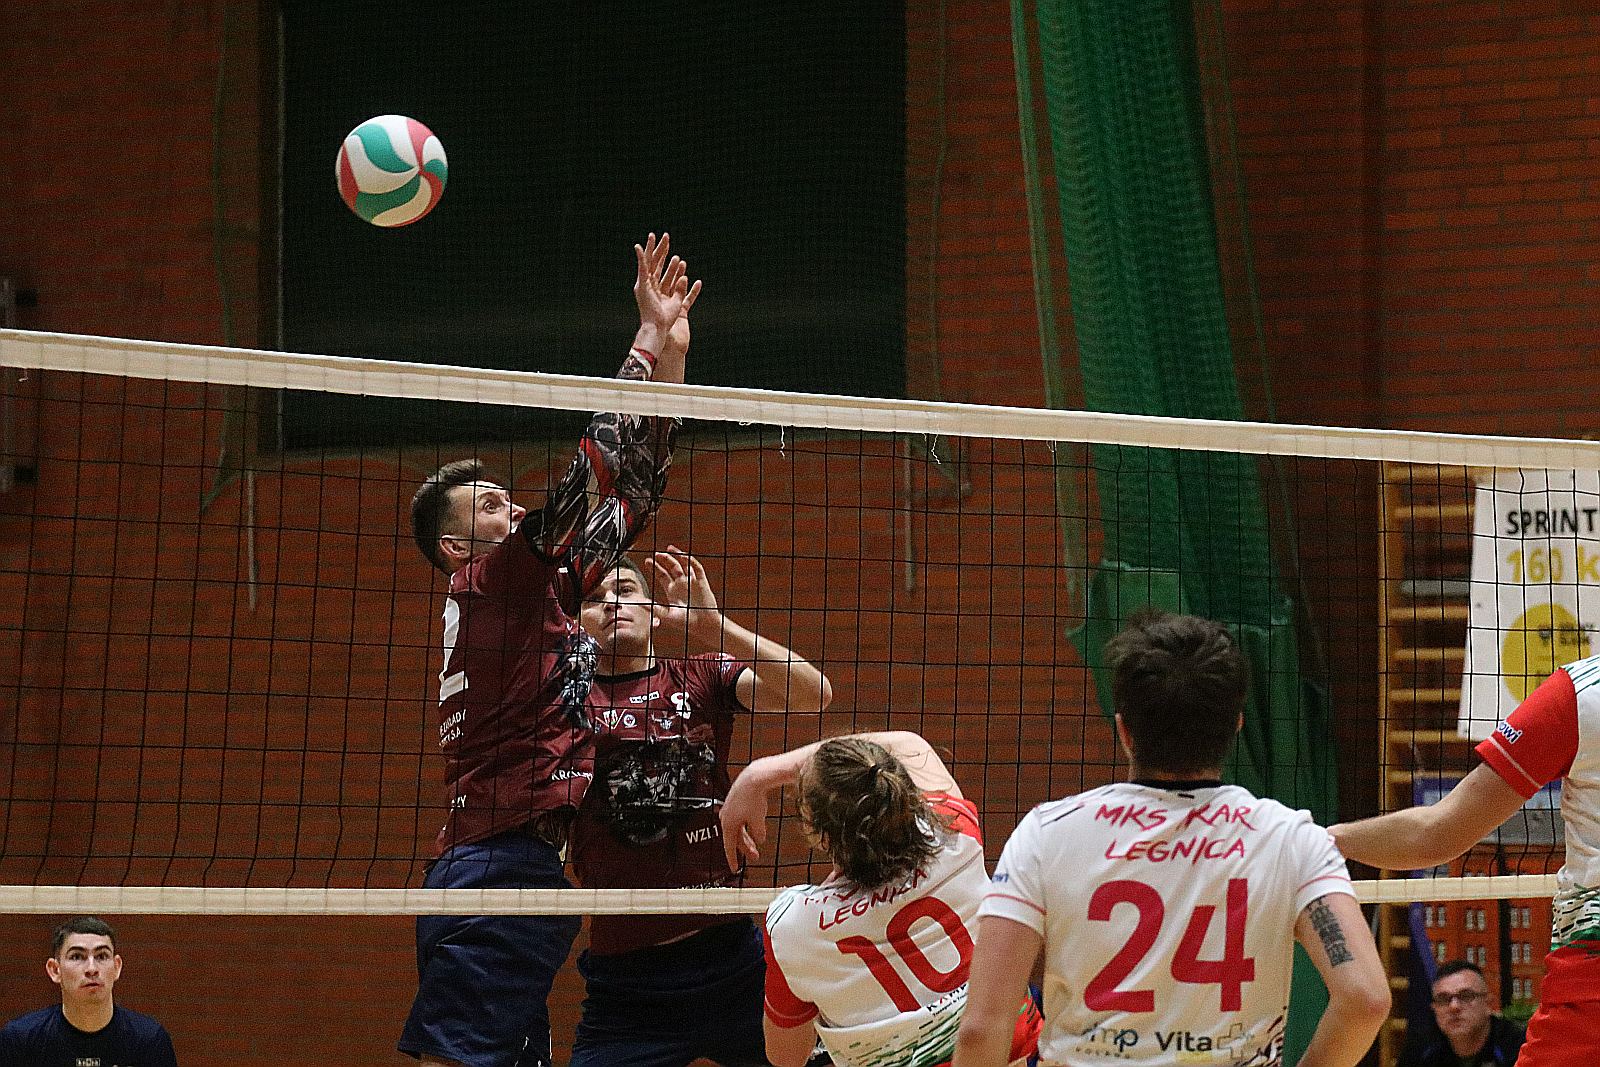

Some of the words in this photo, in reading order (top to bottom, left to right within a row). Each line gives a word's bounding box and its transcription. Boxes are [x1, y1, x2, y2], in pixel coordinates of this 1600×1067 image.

[1506, 508, 1598, 535] SPRINT
[1506, 547, 1563, 583] 160
[1095, 804, 1167, 831] MKS
[1176, 803, 1254, 830] KAR
[1105, 836, 1245, 864] LEGNICA
[836, 897, 975, 1013] 10
[1084, 878, 1254, 1012] 24
[1156, 1031, 1212, 1051] Vita
